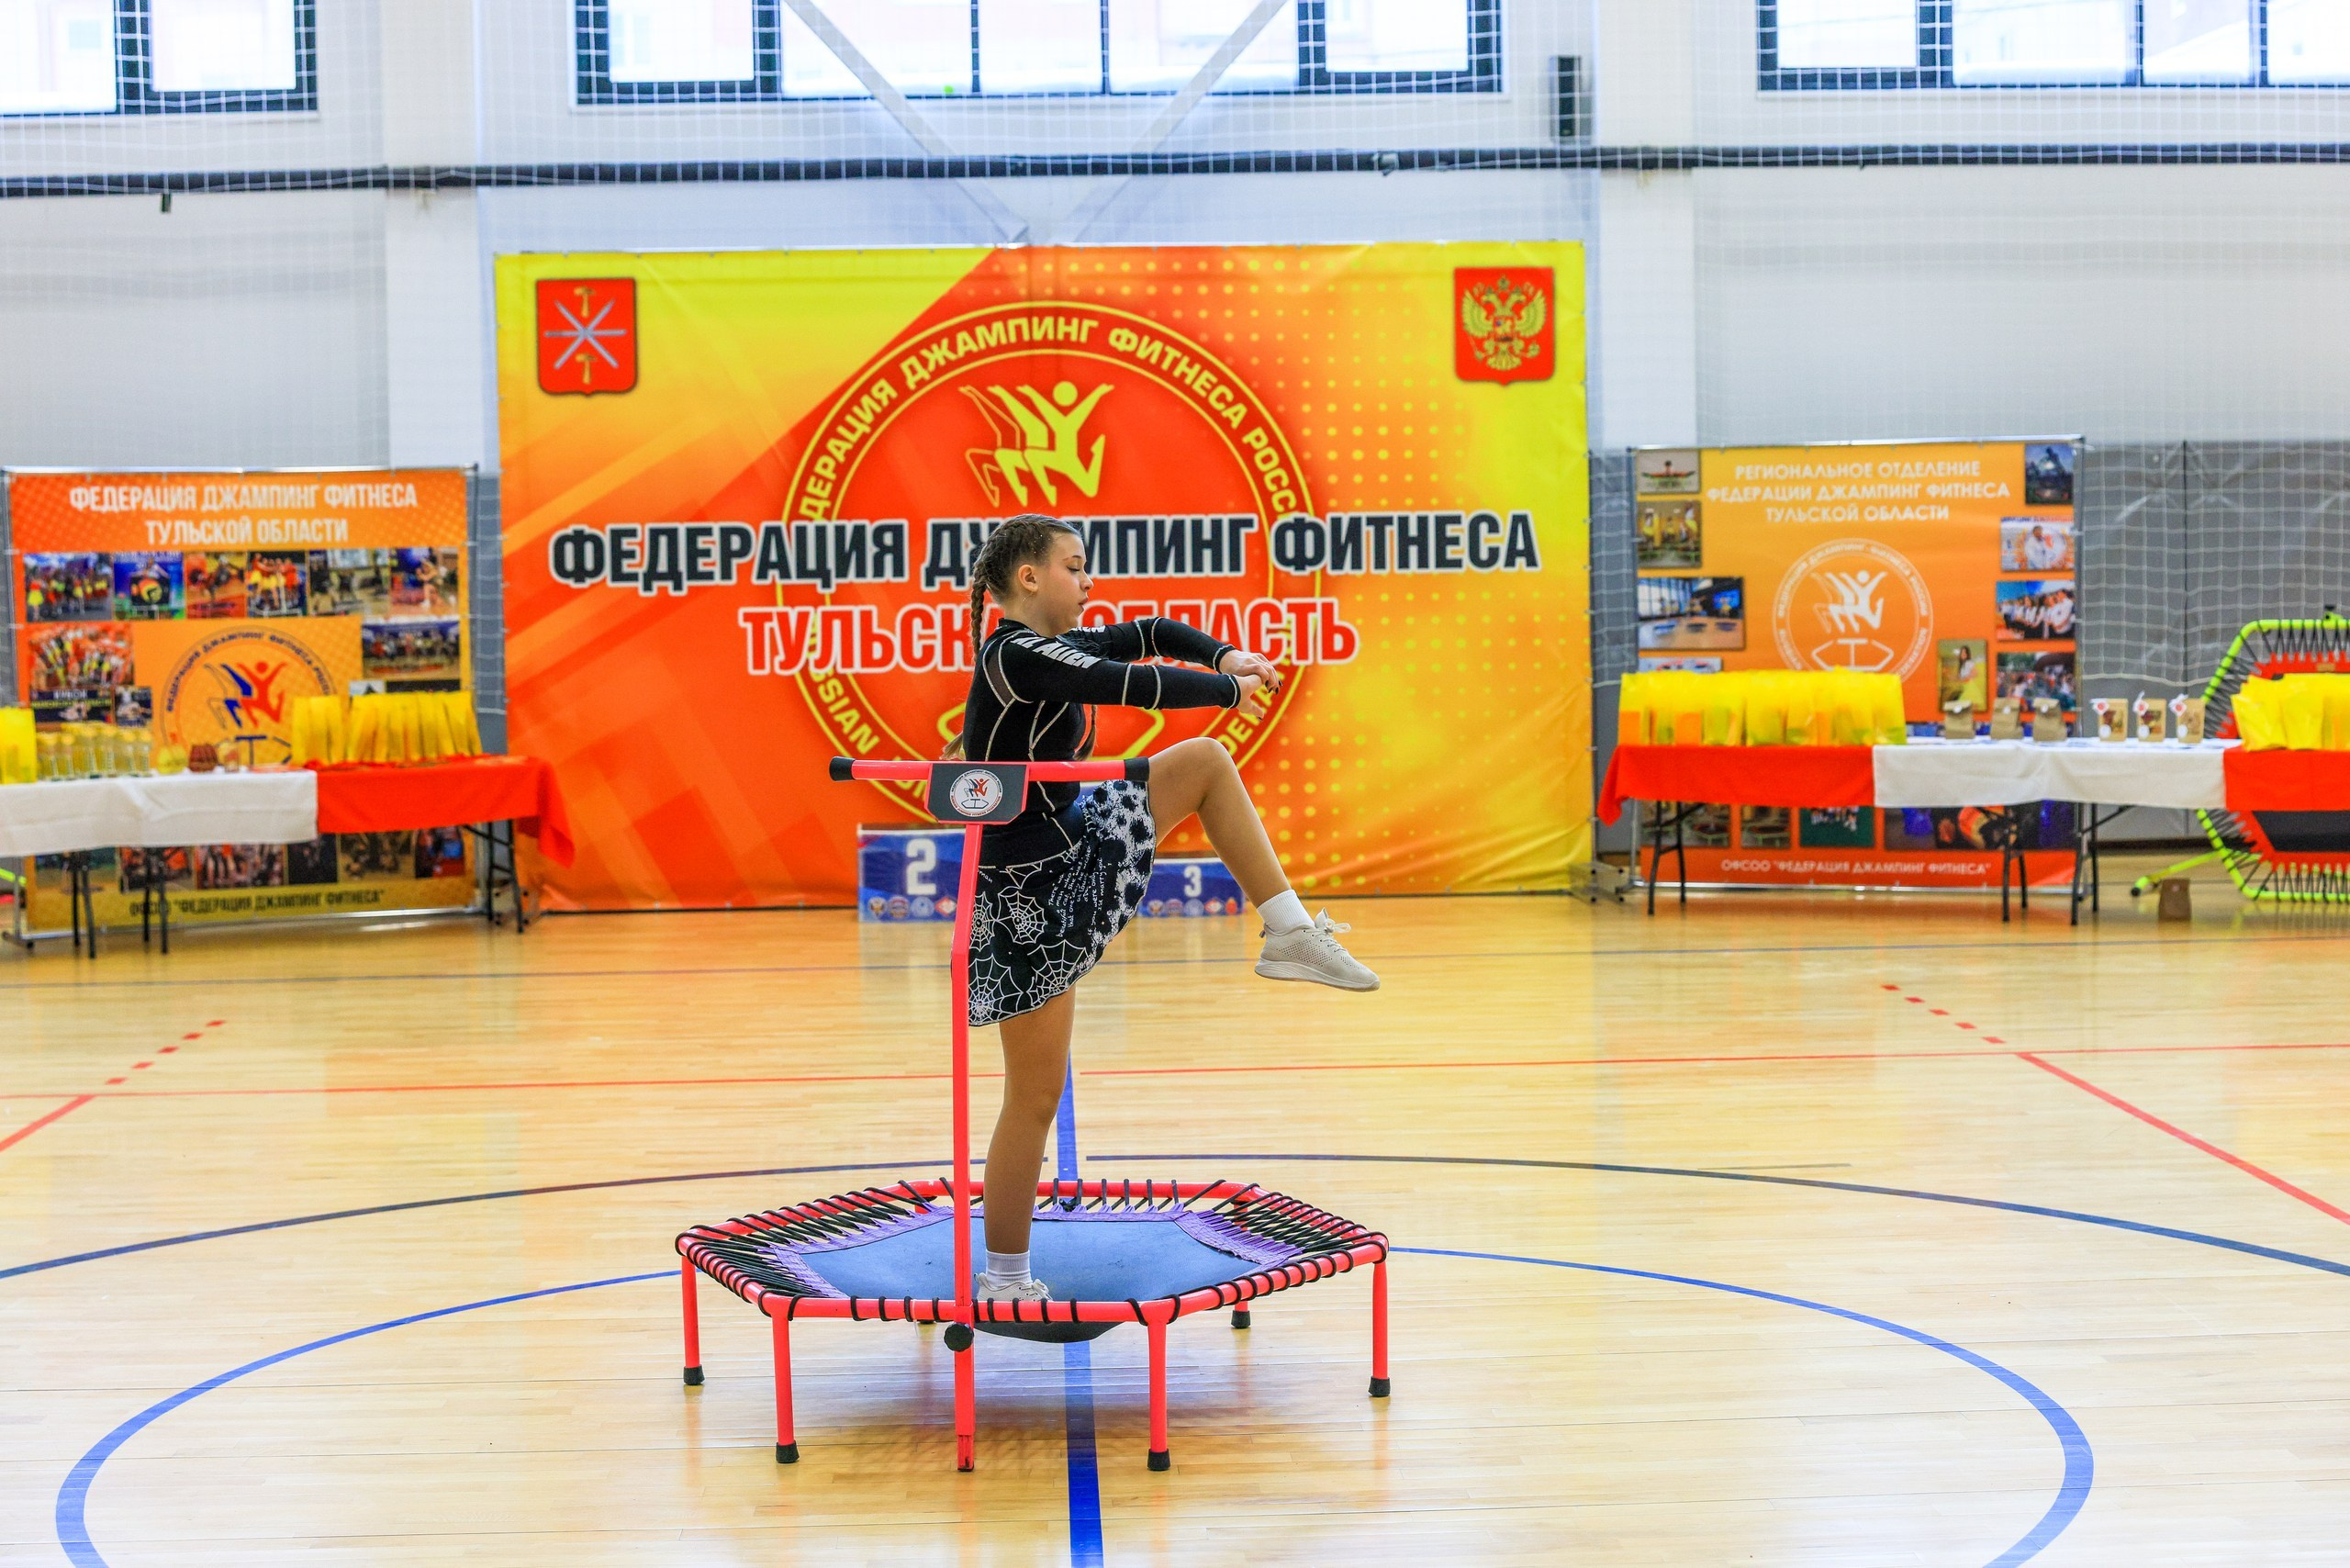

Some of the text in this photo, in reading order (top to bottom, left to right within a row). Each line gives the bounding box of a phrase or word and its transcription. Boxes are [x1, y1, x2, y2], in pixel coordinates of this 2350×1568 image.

[798, 378, 899, 521] ДЕРАЦИЯ
[899, 316, 1100, 390] ДЖАМПИНГ
[1108, 327, 1248, 430] ФИТНЕСА
[1735, 460, 1981, 480] РЕГИОНАЛЬНОЕ ОТДЕЛЕНИЕ
[69, 482, 418, 512] ФЕДЕРАЦИЯ ДЖАМПИНГ ФИТНЕСА
[1707, 481, 2010, 503] ФЕДЕРАЦИИ ДЖАМПИНГ ФИТНЕСА
[1765, 503, 1949, 522] ТУЛЬСКОЙ ОБЛАСТИ
[144, 516, 349, 545] ТУЛЬСКОЙ ОБЛАСТИ
[552, 521, 908, 595] ФЕДЕРАЦИЯ
[1272, 510, 1542, 575] ФИТНЕСА
[1032, 642, 1102, 669] ALIEN
[906, 837, 937, 896] 2
[1183, 864, 1203, 898] 3
